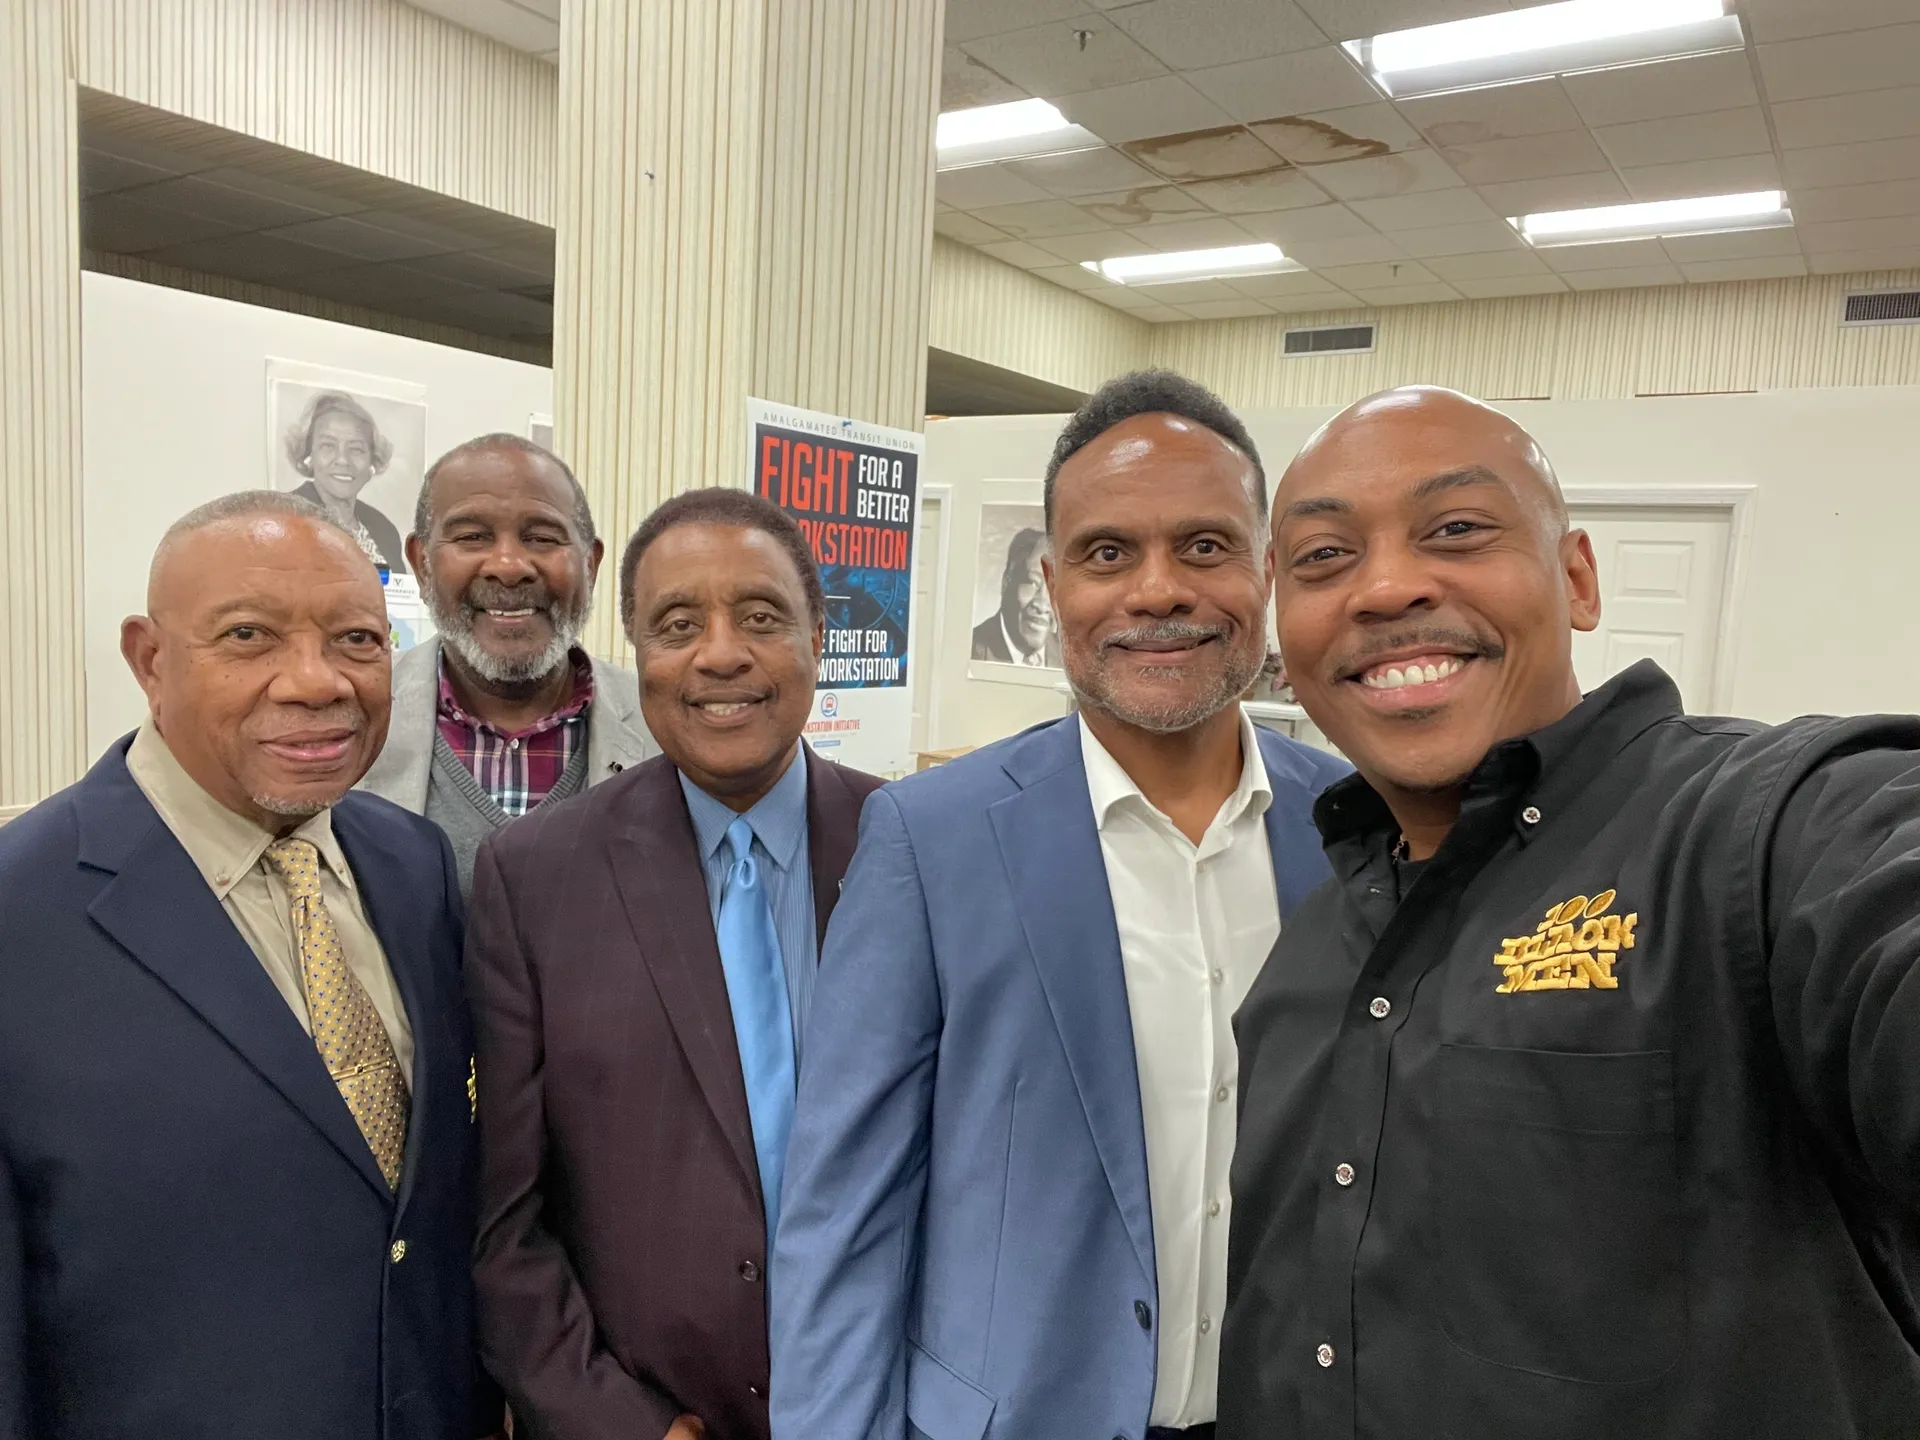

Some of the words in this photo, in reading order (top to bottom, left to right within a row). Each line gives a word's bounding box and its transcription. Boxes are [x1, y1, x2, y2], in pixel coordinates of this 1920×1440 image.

[763, 412, 837, 435] AMALGAMATED
[841, 427, 881, 443] TRANSIT
[885, 436, 915, 450] UNION
[760, 435, 854, 515] FIGHT
[858, 453, 888, 487] FOR
[891, 460, 903, 489] A
[856, 488, 910, 523] BETTER
[798, 519, 908, 570] KSTATION
[828, 629, 863, 653] FIGHT
[865, 629, 888, 653] FOR
[818, 657, 899, 682] WORKSTATION
[833, 719, 861, 731] INITIATIVE
[1537, 888, 1616, 933] 100
[1495, 951, 1619, 994] MEN
